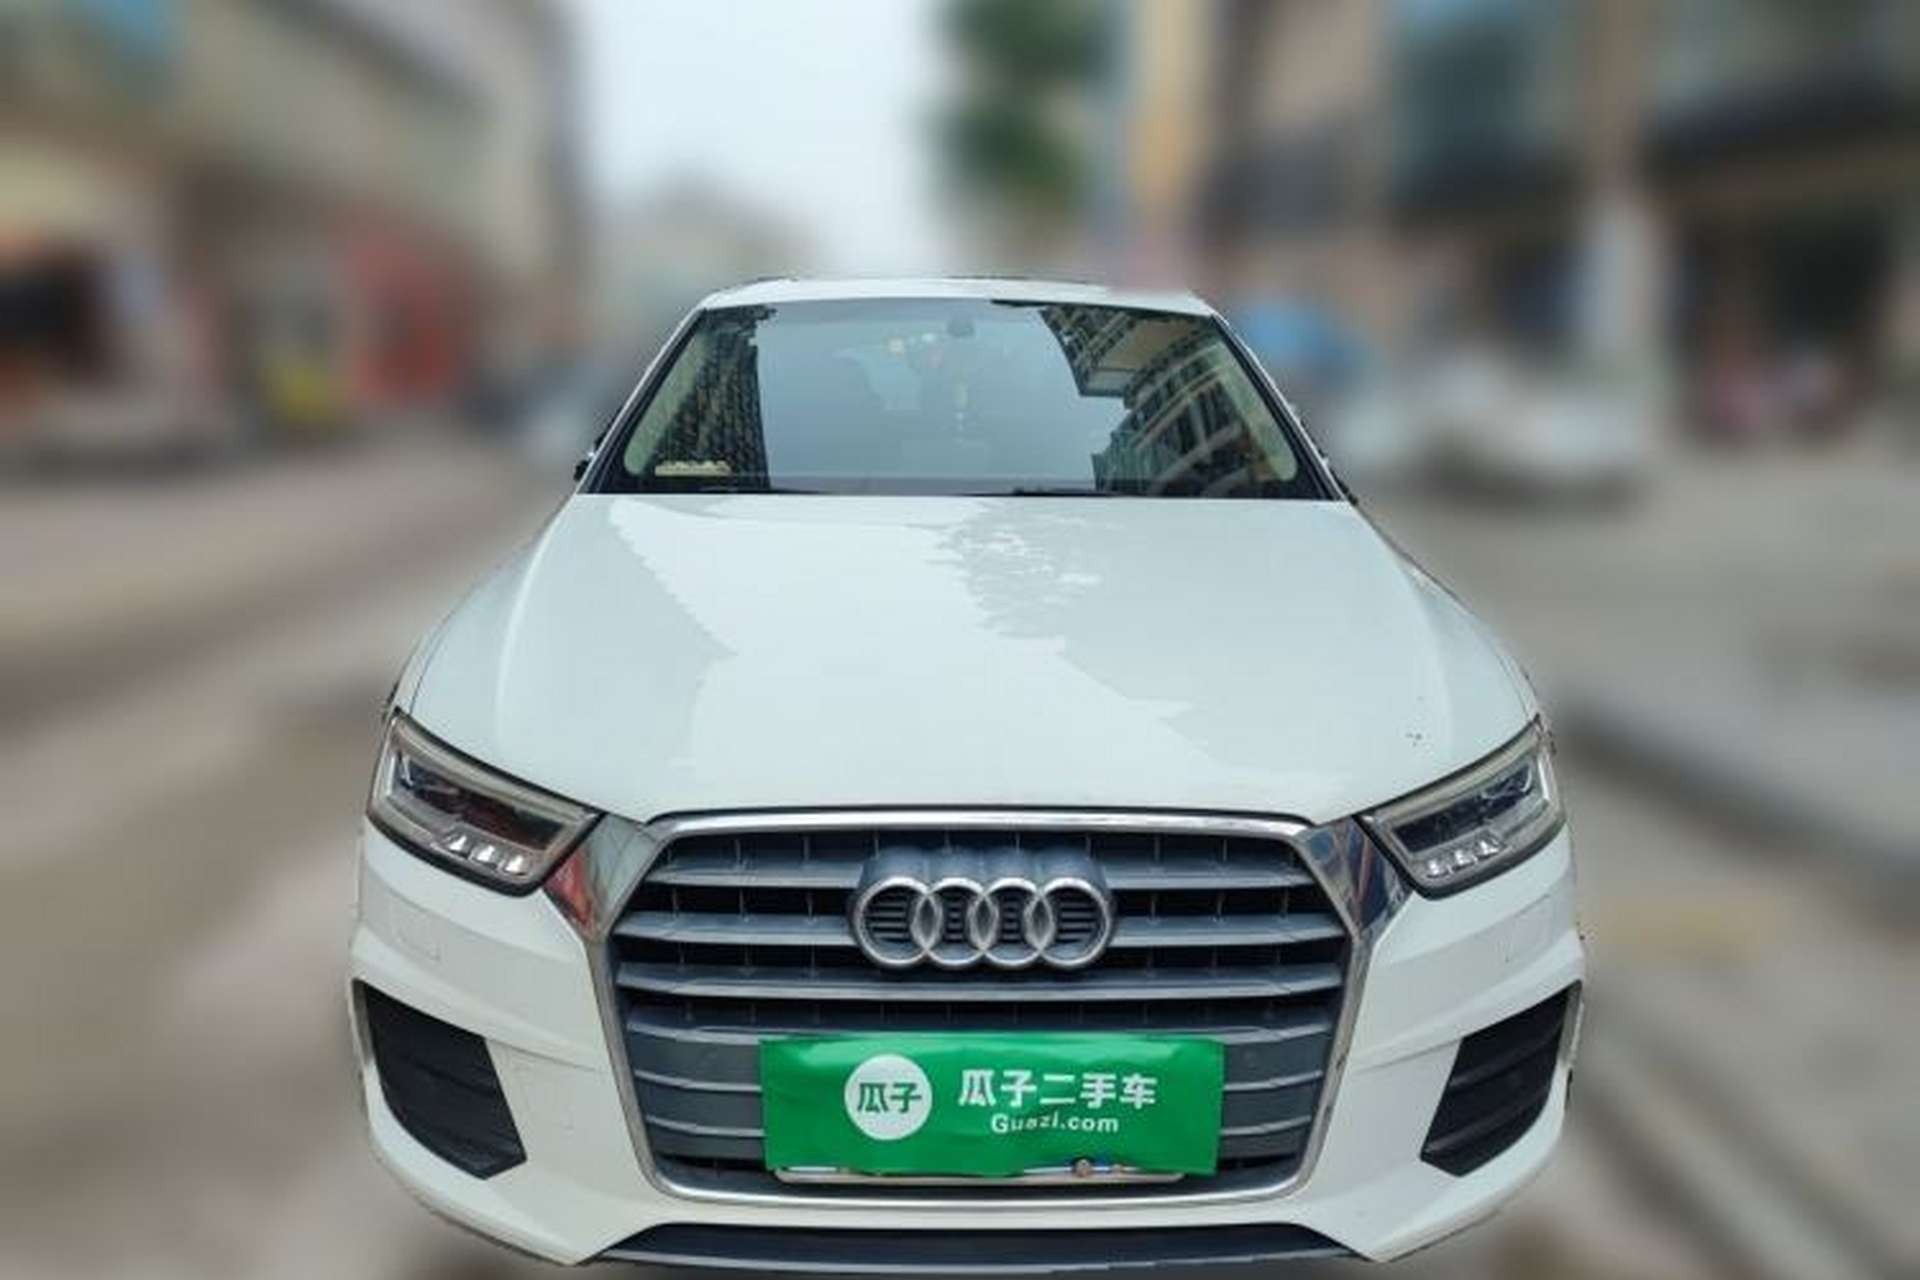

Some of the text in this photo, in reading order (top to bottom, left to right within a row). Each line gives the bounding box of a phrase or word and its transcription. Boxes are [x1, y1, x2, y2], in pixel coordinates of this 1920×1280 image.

[857, 1082, 922, 1114] 瓜子
[958, 1069, 1158, 1109] 瓜子二手车
[990, 1113, 1119, 1134] Guazi.com
